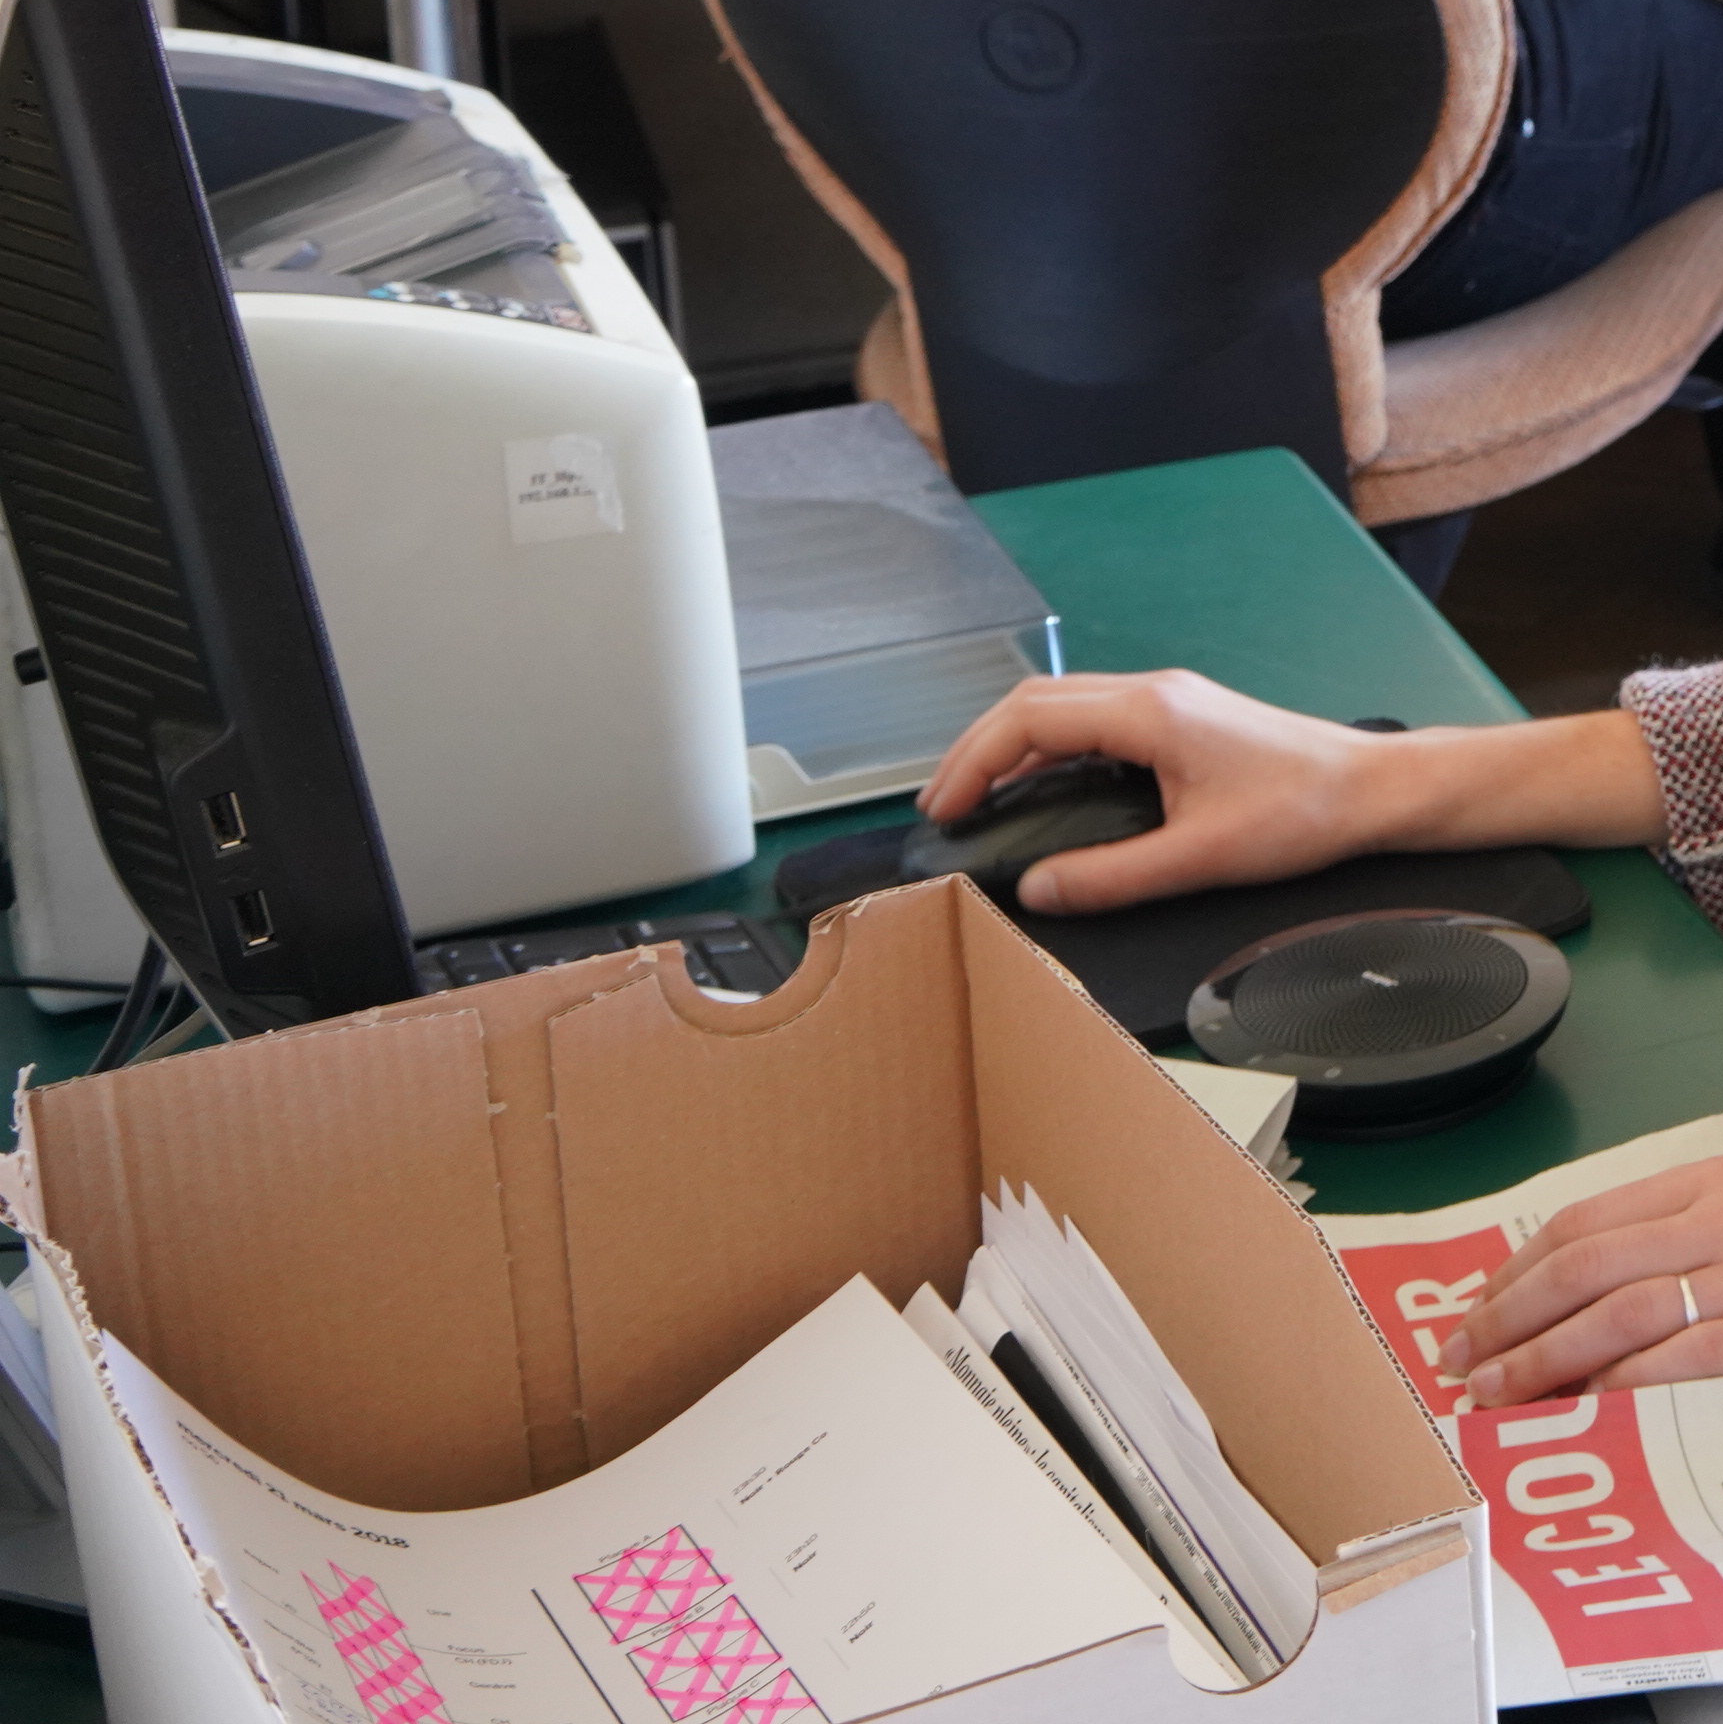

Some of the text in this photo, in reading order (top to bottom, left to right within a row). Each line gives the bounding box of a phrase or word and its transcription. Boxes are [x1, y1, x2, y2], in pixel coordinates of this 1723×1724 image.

[740, 1483, 764, 1506] Noir
[291, 1501, 348, 1532] mars
[349, 1526, 411, 1549] 2018
[792, 1550, 818, 1573] Noir
[1551, 1554, 1693, 1617] LE
[849, 1621, 874, 1644] Noir
